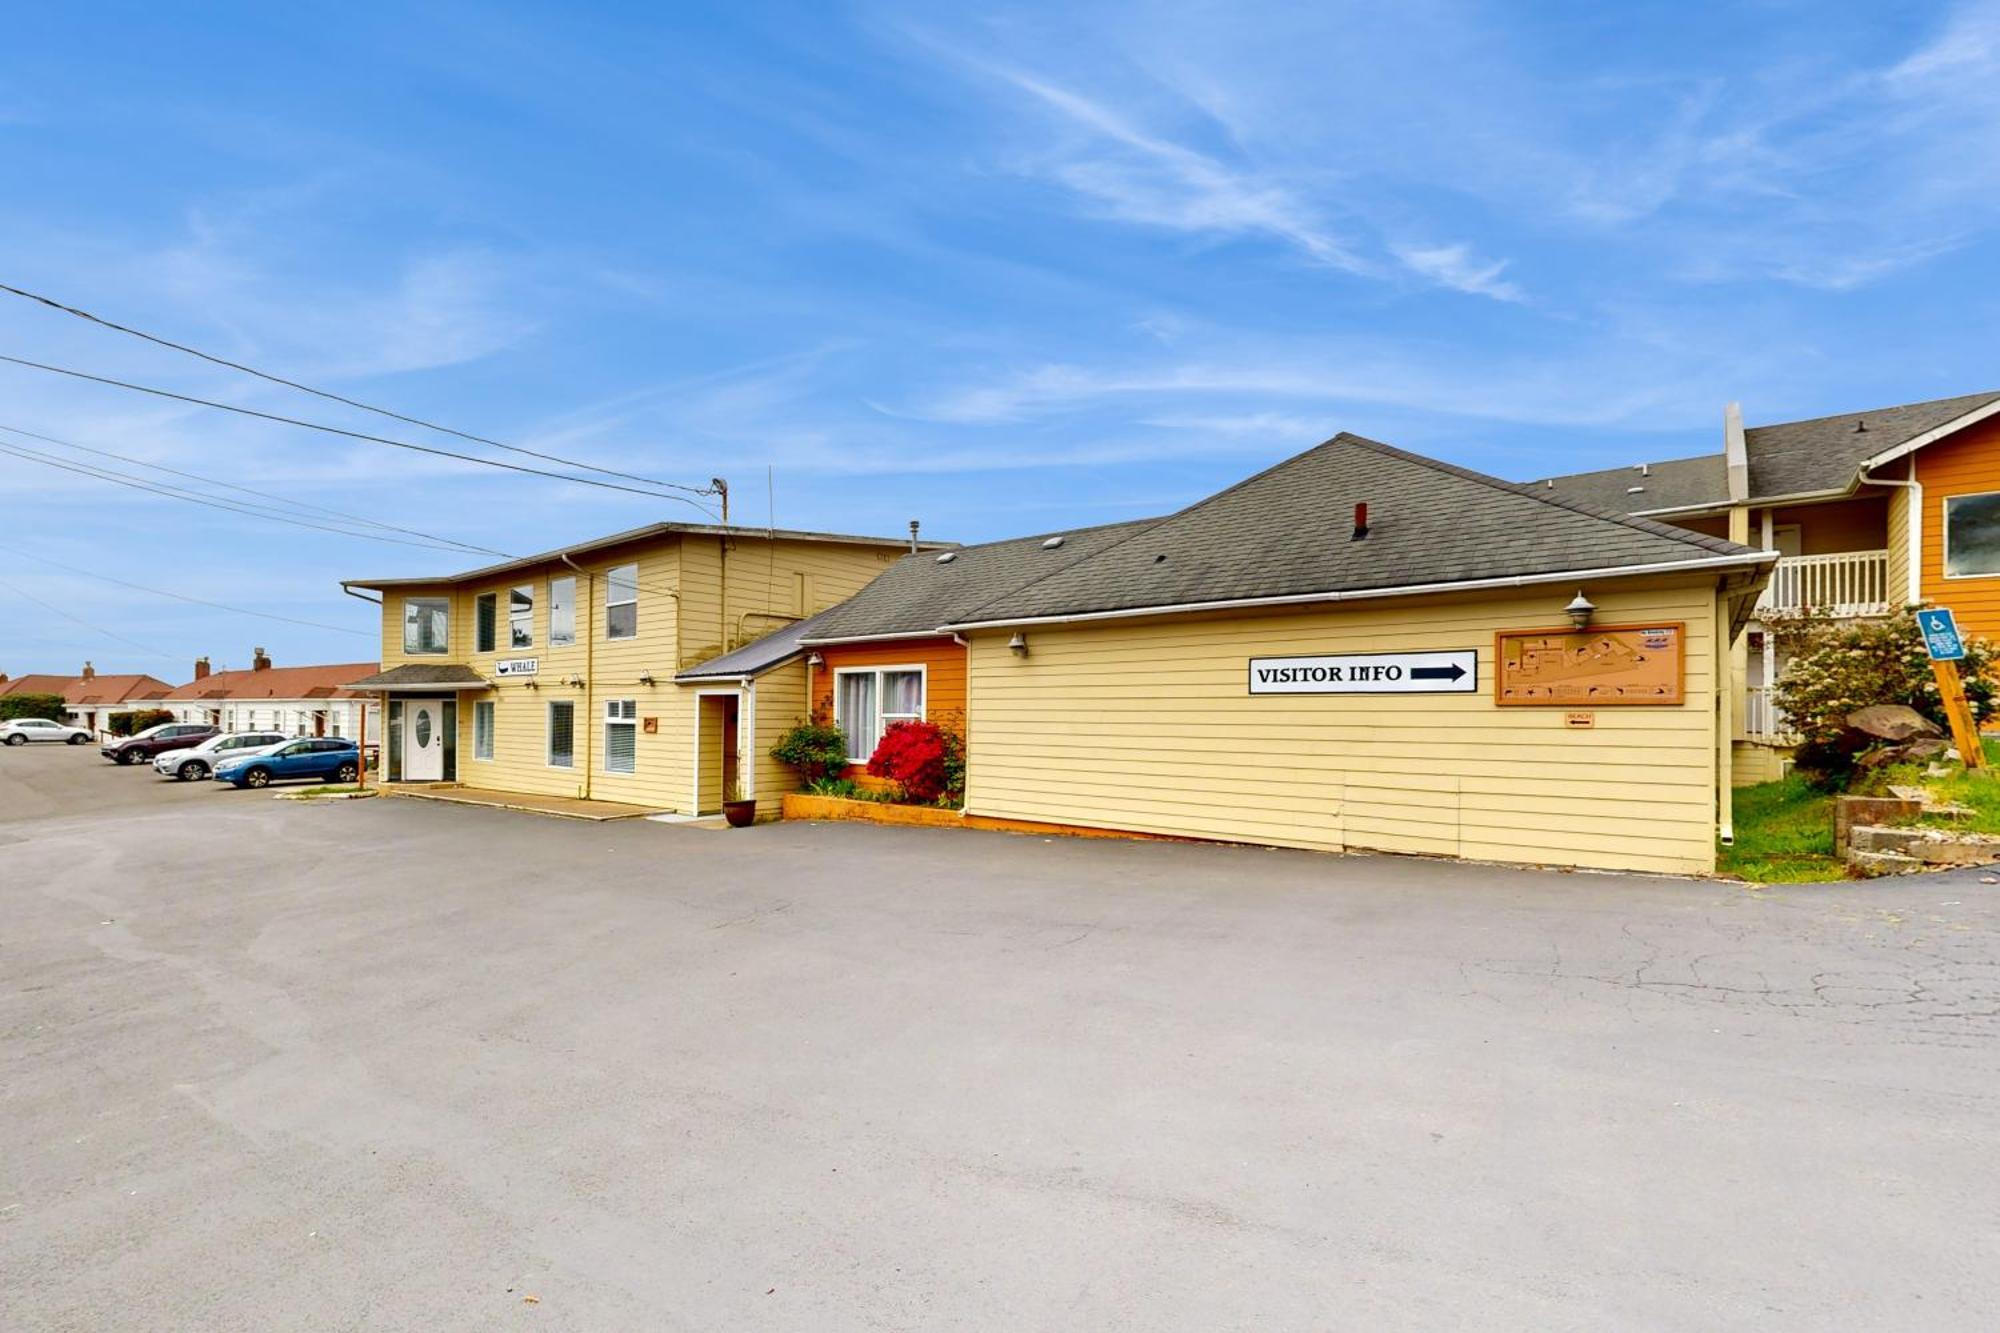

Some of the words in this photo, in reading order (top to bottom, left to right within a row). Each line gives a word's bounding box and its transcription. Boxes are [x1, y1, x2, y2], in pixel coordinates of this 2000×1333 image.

[510, 661, 535, 672] WHALE
[1258, 667, 1343, 683] VISITOR
[1349, 665, 1402, 681] INFO
[1567, 712, 1591, 720] BEACH
